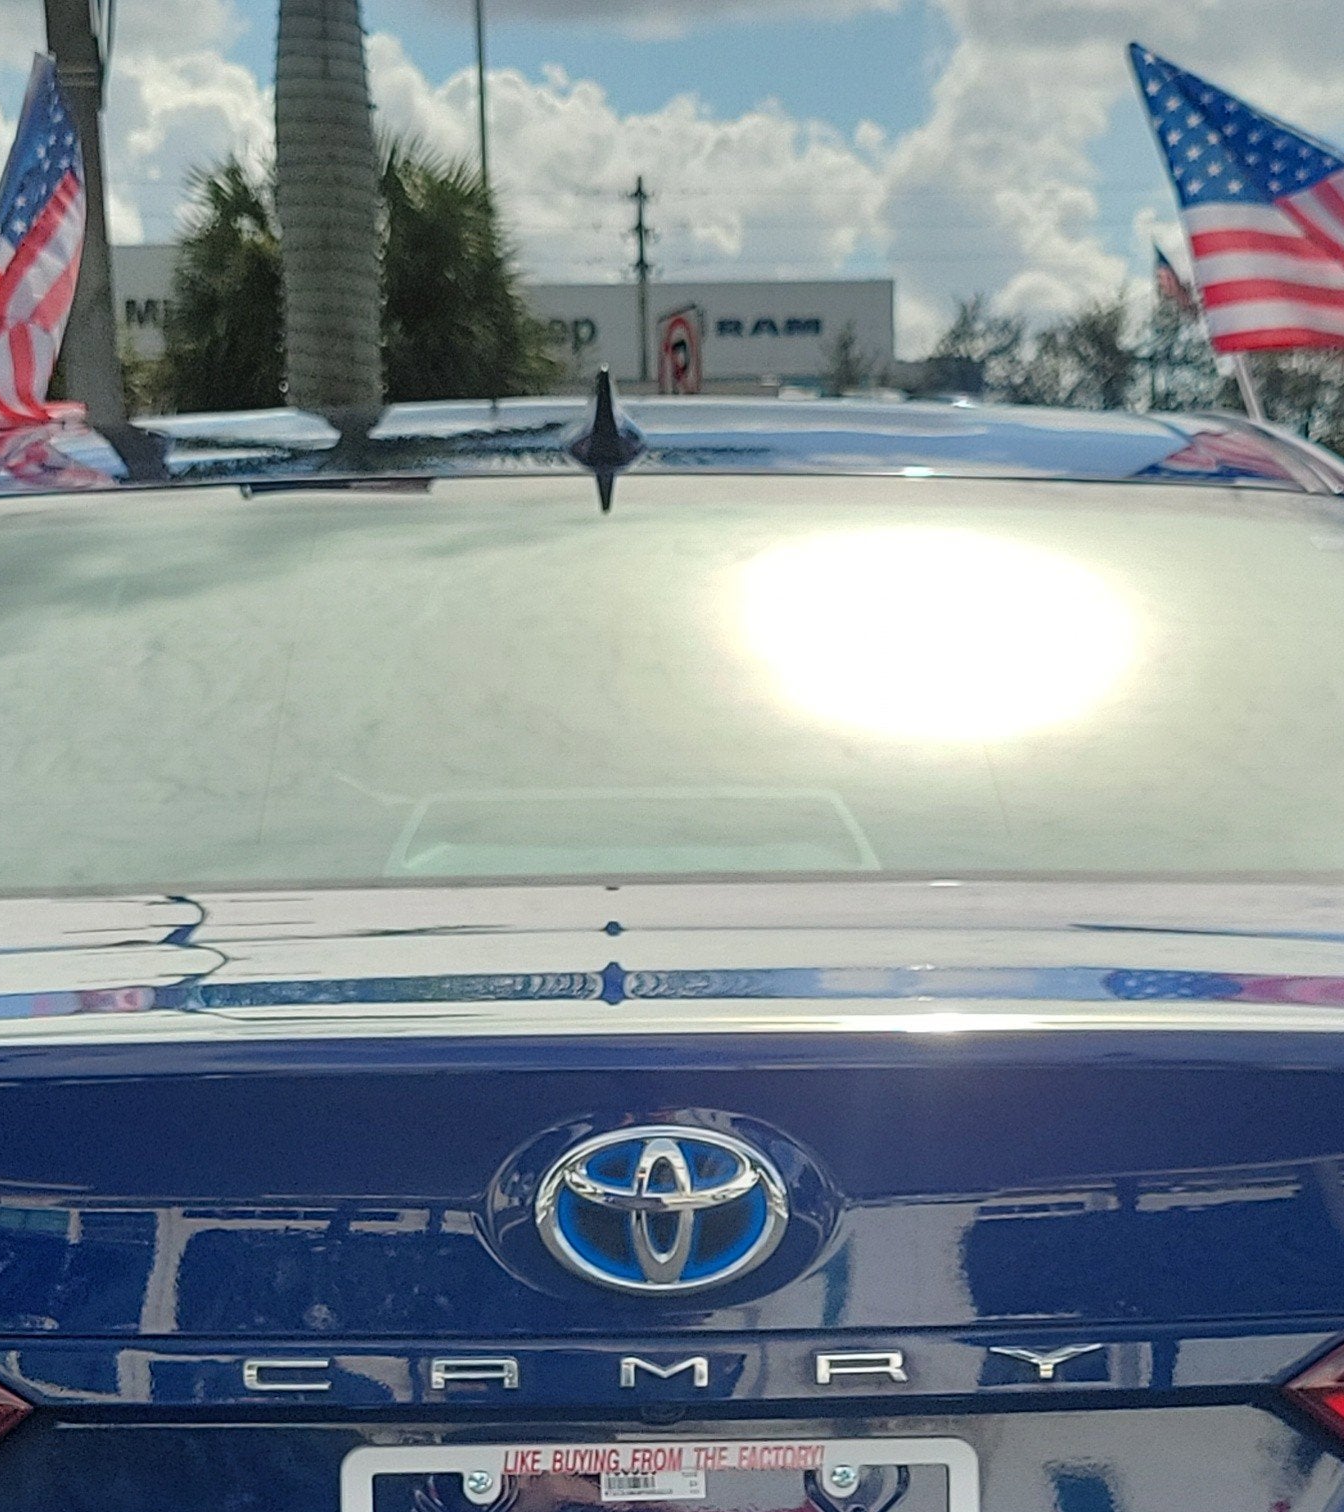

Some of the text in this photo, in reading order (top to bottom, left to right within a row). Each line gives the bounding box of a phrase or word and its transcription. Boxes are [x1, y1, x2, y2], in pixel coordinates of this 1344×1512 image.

[547, 317, 598, 354] ep
[715, 318, 822, 337] RAM
[243, 1342, 1103, 1391] CAMRY
[505, 1445, 825, 1472] LIKE BUYING FROM THE FACTORY!
